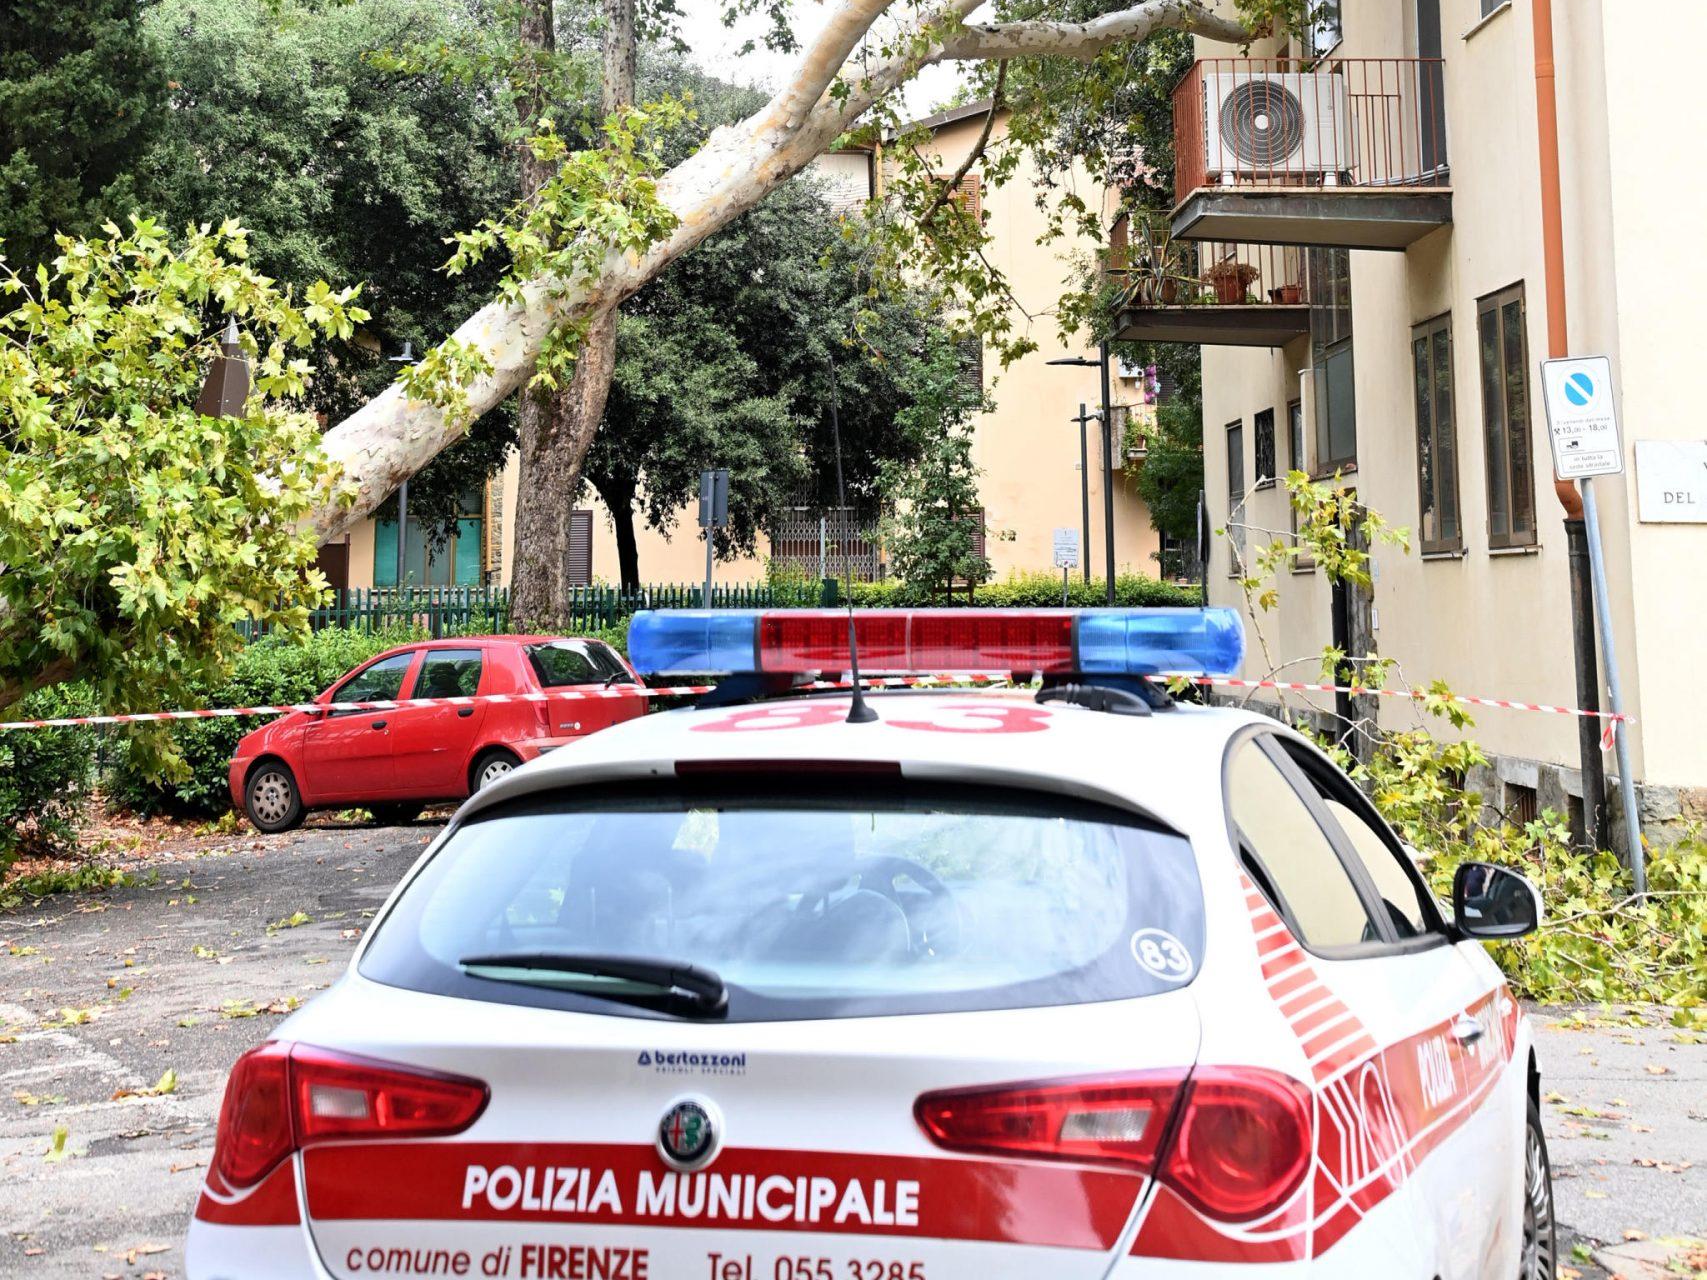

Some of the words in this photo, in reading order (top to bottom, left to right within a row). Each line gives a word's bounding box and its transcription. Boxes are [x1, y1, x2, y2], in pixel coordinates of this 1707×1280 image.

[1664, 491, 1696, 504] DEL
[1139, 939, 1188, 971] 83
[462, 1165, 623, 1214] POLIZIA
[636, 1170, 919, 1226] MUNICIPALE
[346, 1247, 470, 1275] comune
[481, 1245, 512, 1276] di
[521, 1244, 649, 1280] FIRENZE
[708, 1253, 758, 1280] Tel
[774, 1255, 833, 1280] 055
[847, 1259, 927, 1280] 3285
